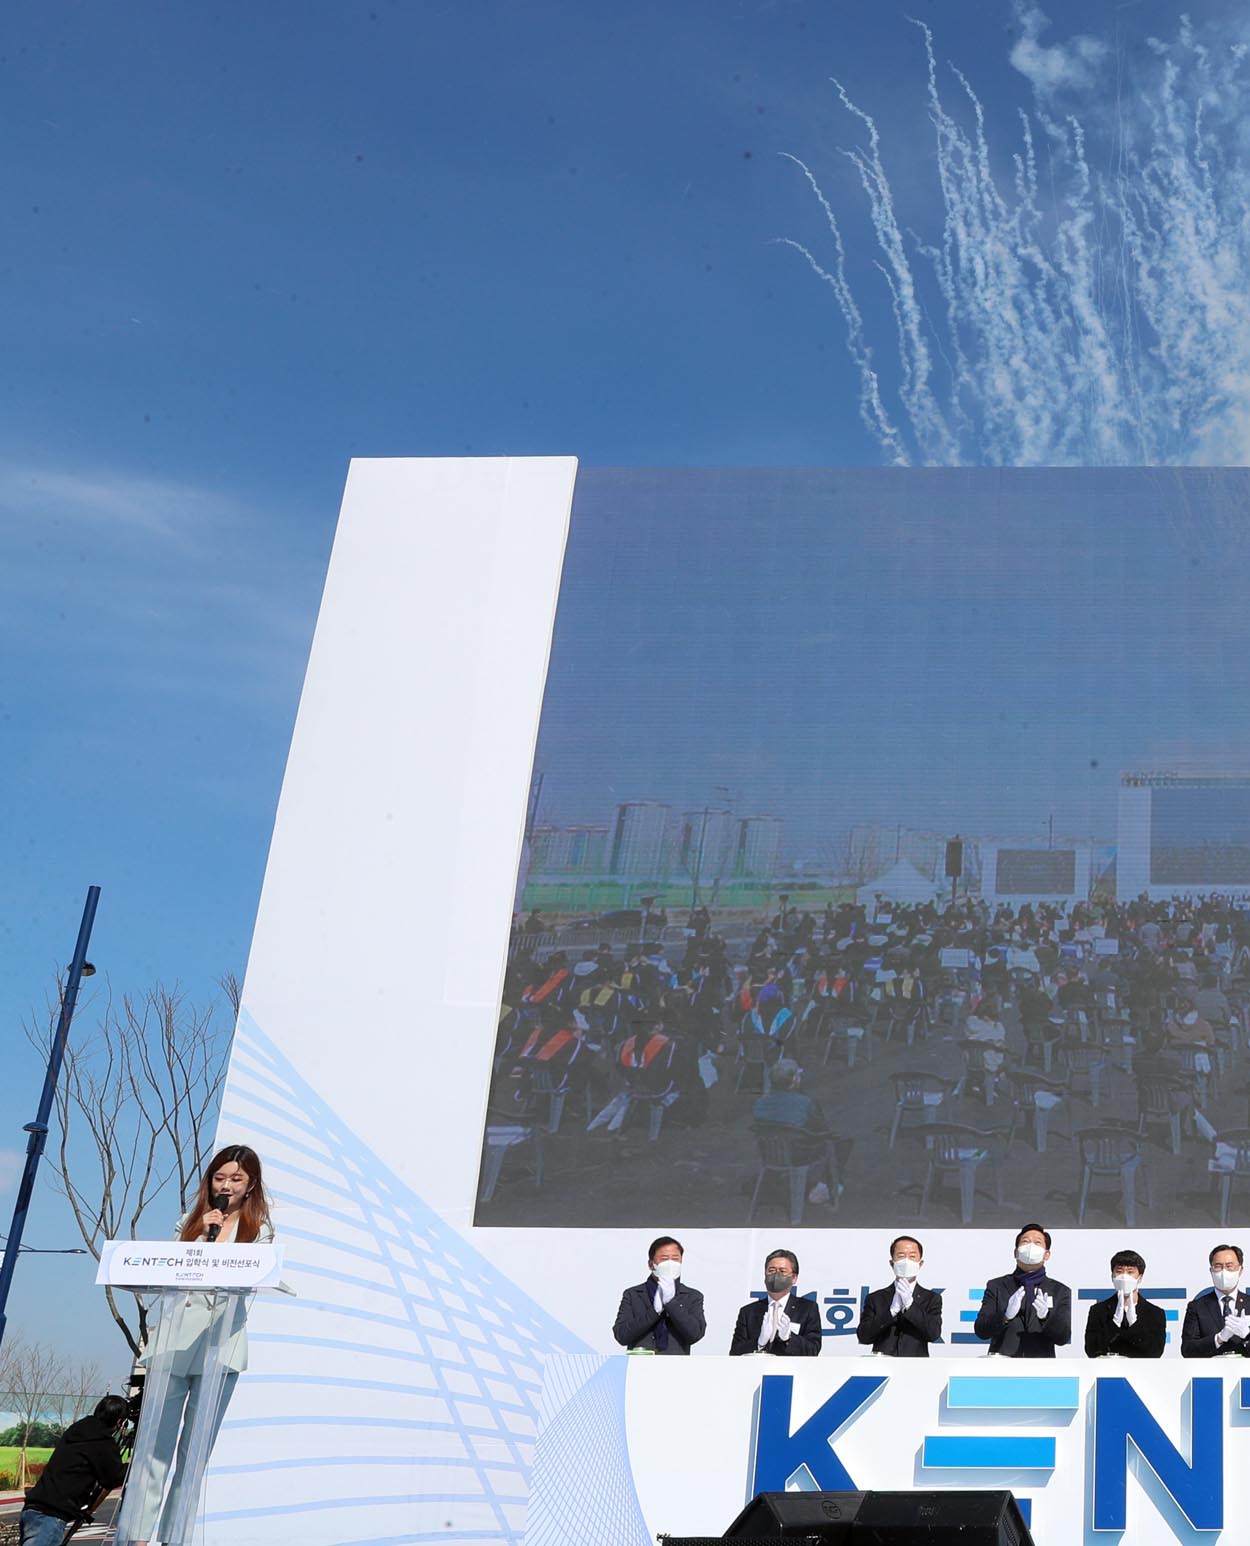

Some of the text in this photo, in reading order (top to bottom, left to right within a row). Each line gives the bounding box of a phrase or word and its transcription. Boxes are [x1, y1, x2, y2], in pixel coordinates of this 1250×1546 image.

[123, 1257, 260, 1268] KENTECH 입학식 및 비전선포식
